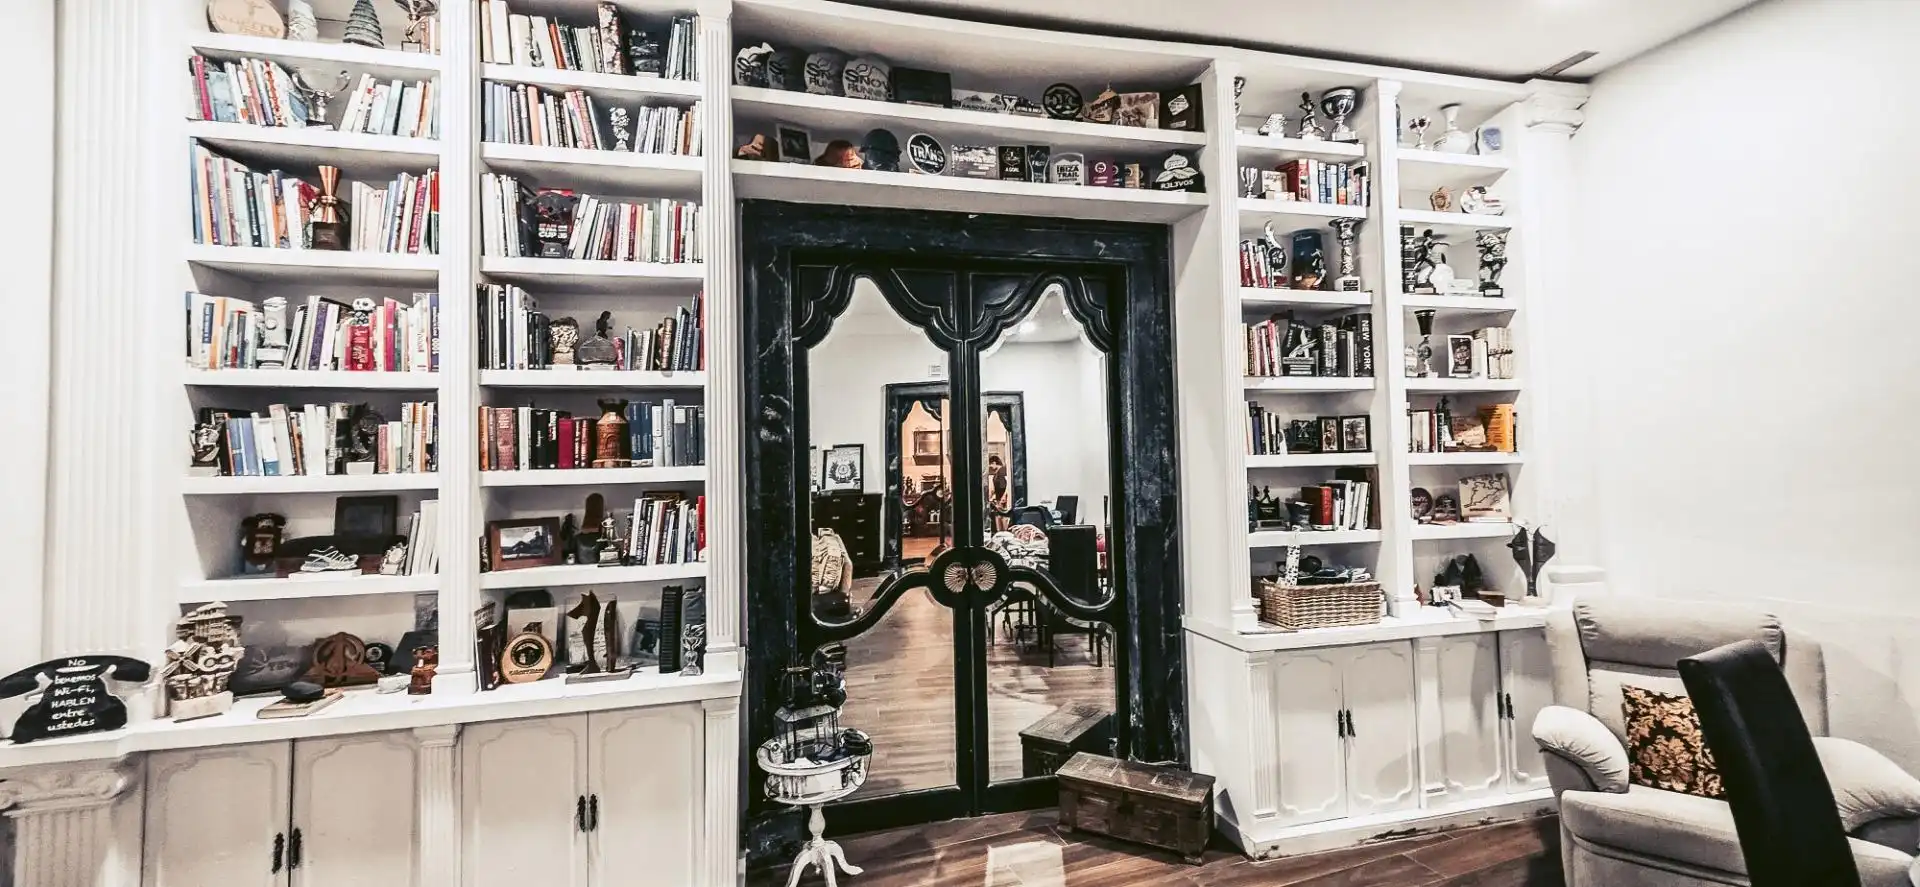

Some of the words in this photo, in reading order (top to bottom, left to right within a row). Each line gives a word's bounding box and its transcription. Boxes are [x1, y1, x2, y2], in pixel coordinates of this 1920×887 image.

[911, 141, 944, 163] TRANS
[1056, 165, 1079, 173] IBIZA
[1362, 320, 1370, 341] NEW
[1363, 345, 1372, 370] YORK
[52, 708, 85, 720] entre
[47, 718, 95, 731] ustedes
